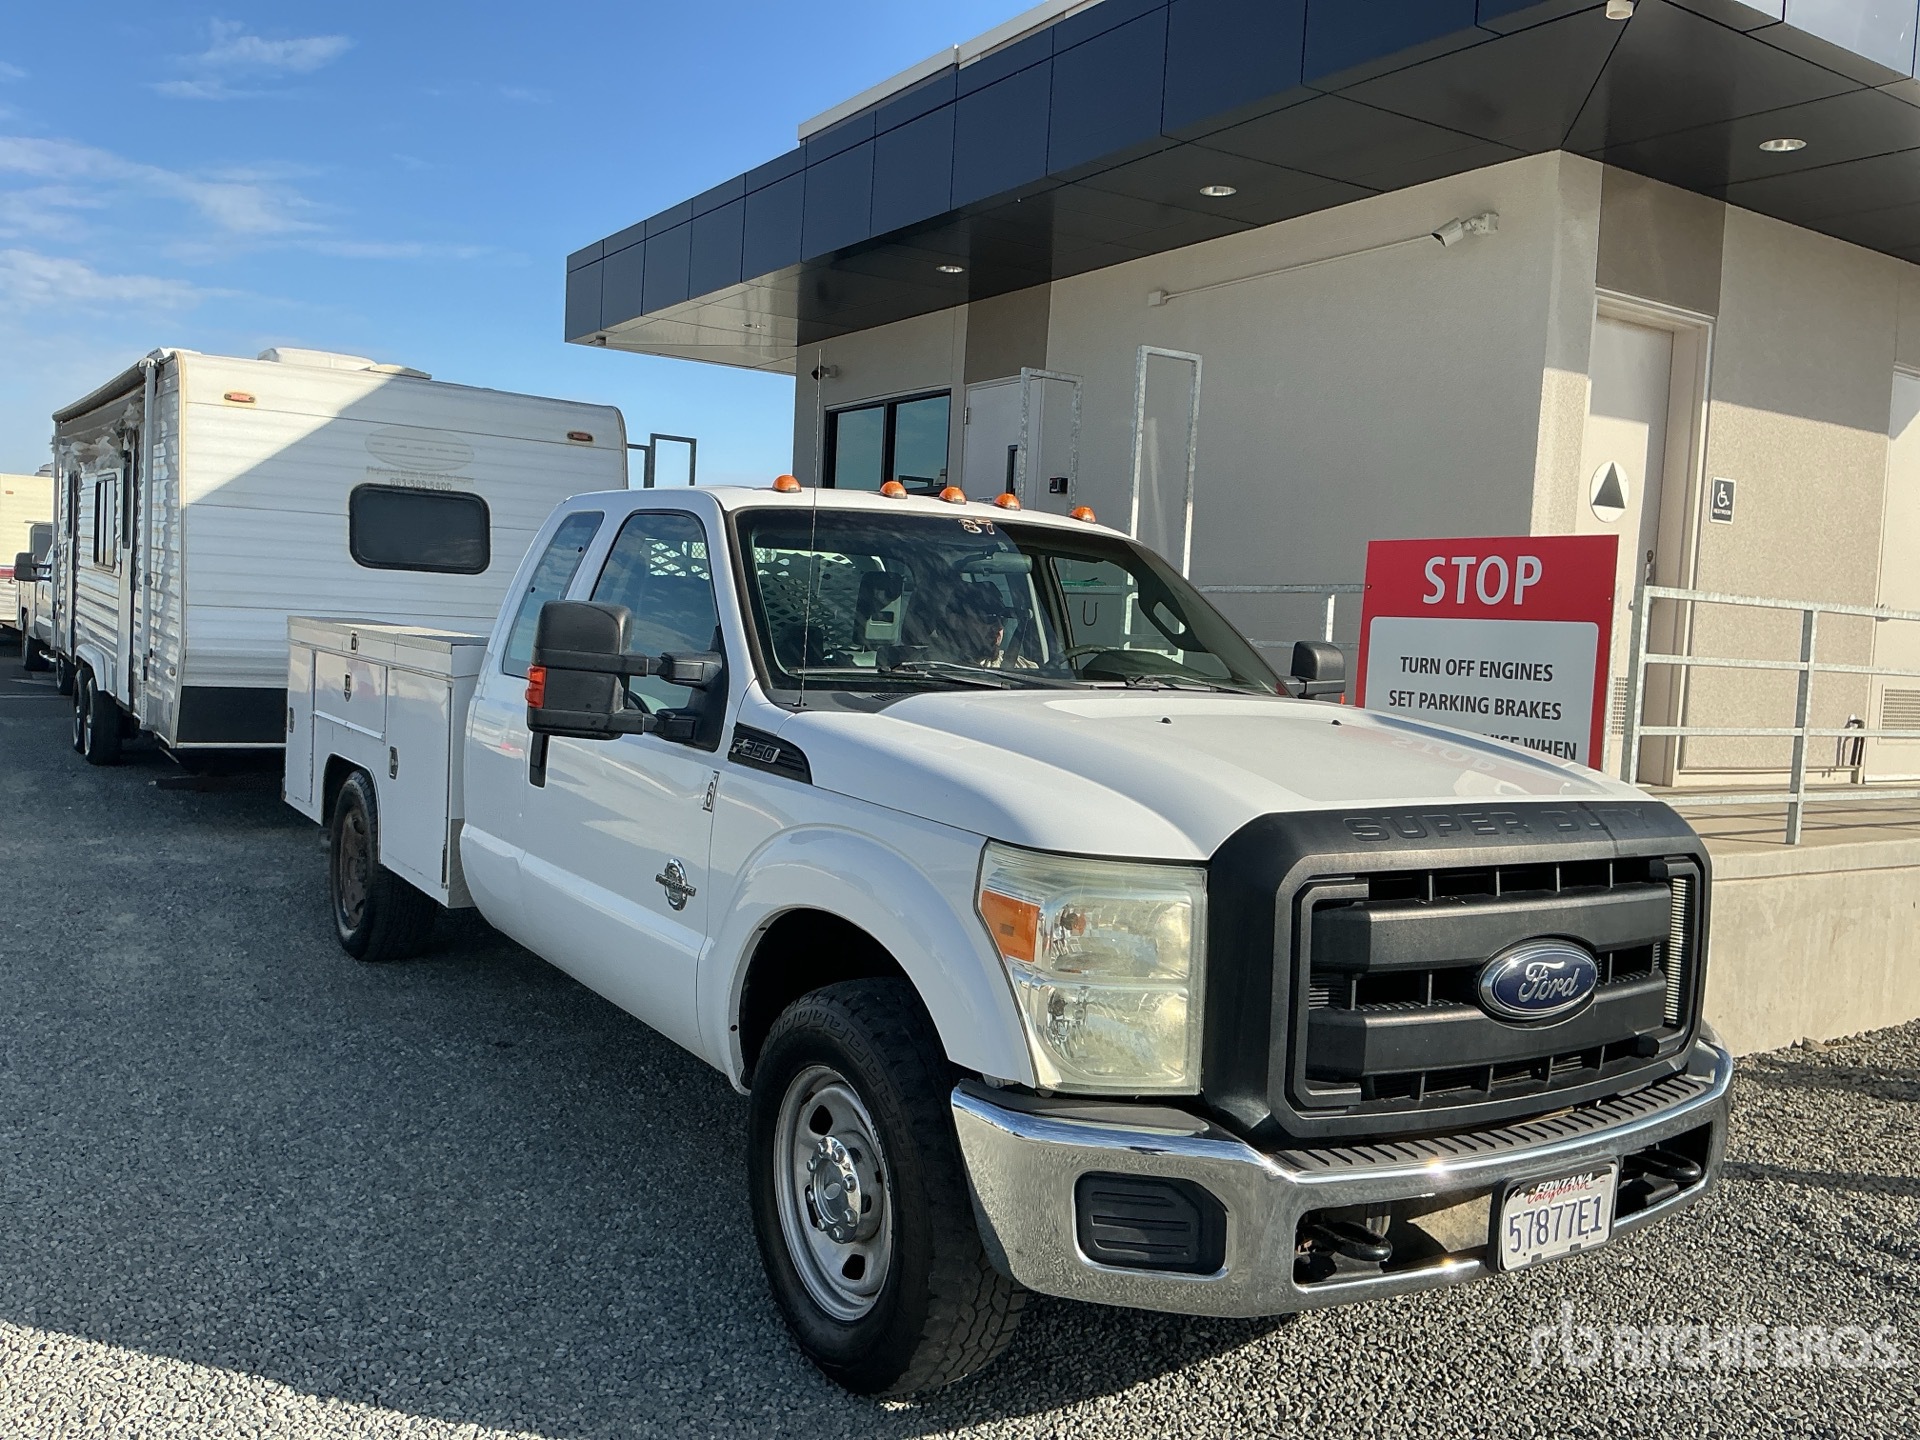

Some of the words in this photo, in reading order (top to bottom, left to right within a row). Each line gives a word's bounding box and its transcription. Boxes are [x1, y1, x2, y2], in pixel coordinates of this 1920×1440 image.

[1422, 555, 1543, 605] STOP
[1400, 656, 1441, 675] TURN
[1445, 658, 1475, 677] OFF
[1479, 661, 1553, 682] ENGINES
[1389, 690, 1415, 708] SET
[1418, 692, 1489, 714] PARKING
[1494, 699, 1562, 721] BRAKES
[1343, 811, 1533, 842] SUPER
[1540, 807, 1650, 833] DUTY
[1518, 960, 1580, 1003] Ford
[1536, 1172, 1594, 1193] FONTANA
[1509, 1195, 1602, 1253] 57877E1
